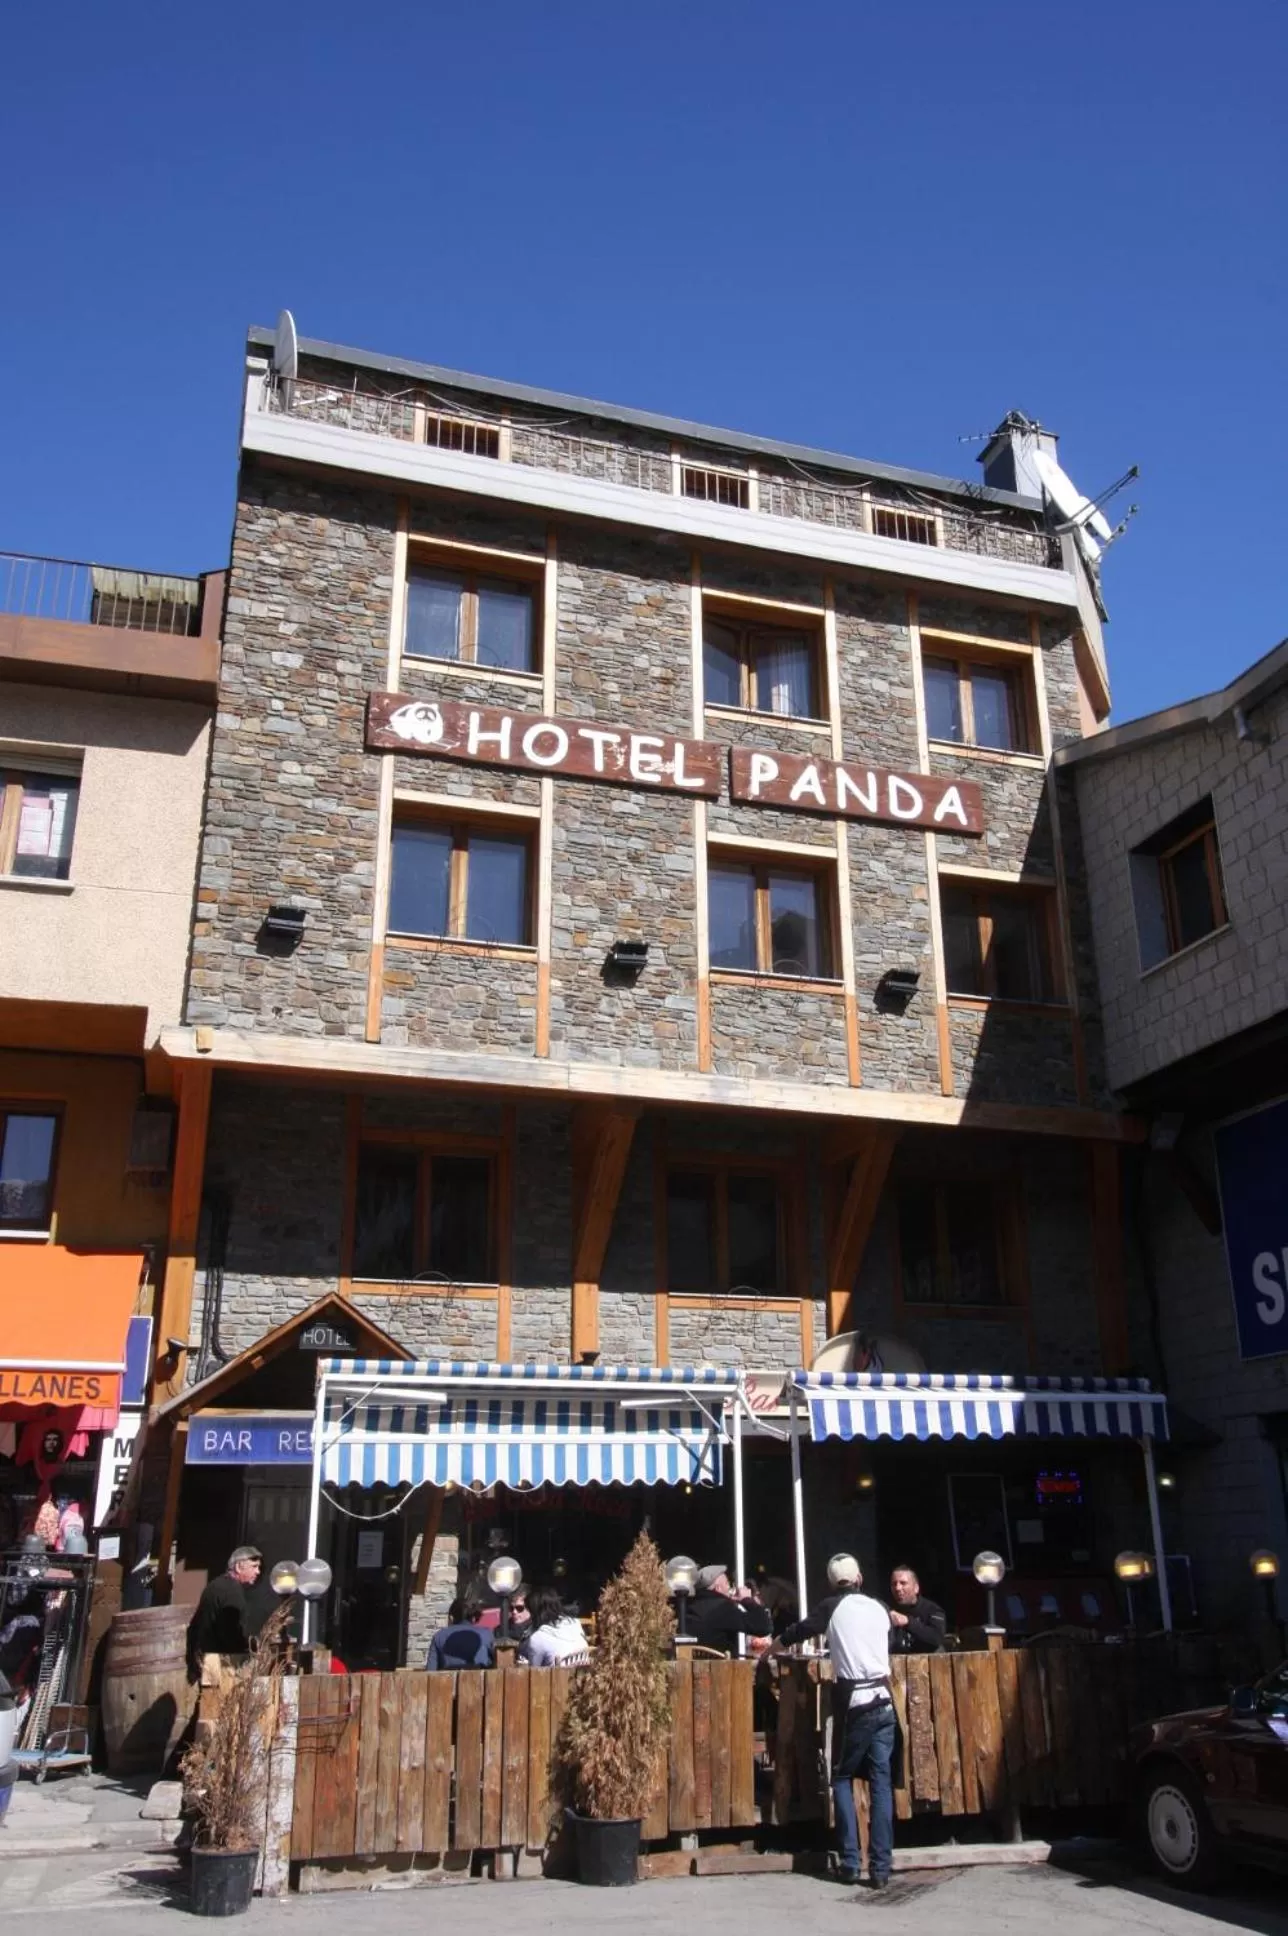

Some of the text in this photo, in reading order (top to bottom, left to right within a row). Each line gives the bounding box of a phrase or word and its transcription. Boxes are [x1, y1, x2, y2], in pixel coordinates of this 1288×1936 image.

[467, 711, 968, 826] HOTEL PANDA
[1252, 1247, 1288, 1325] S
[302, 1328, 350, 1346] HOTEL
[204, 1430, 253, 1451] BAR
